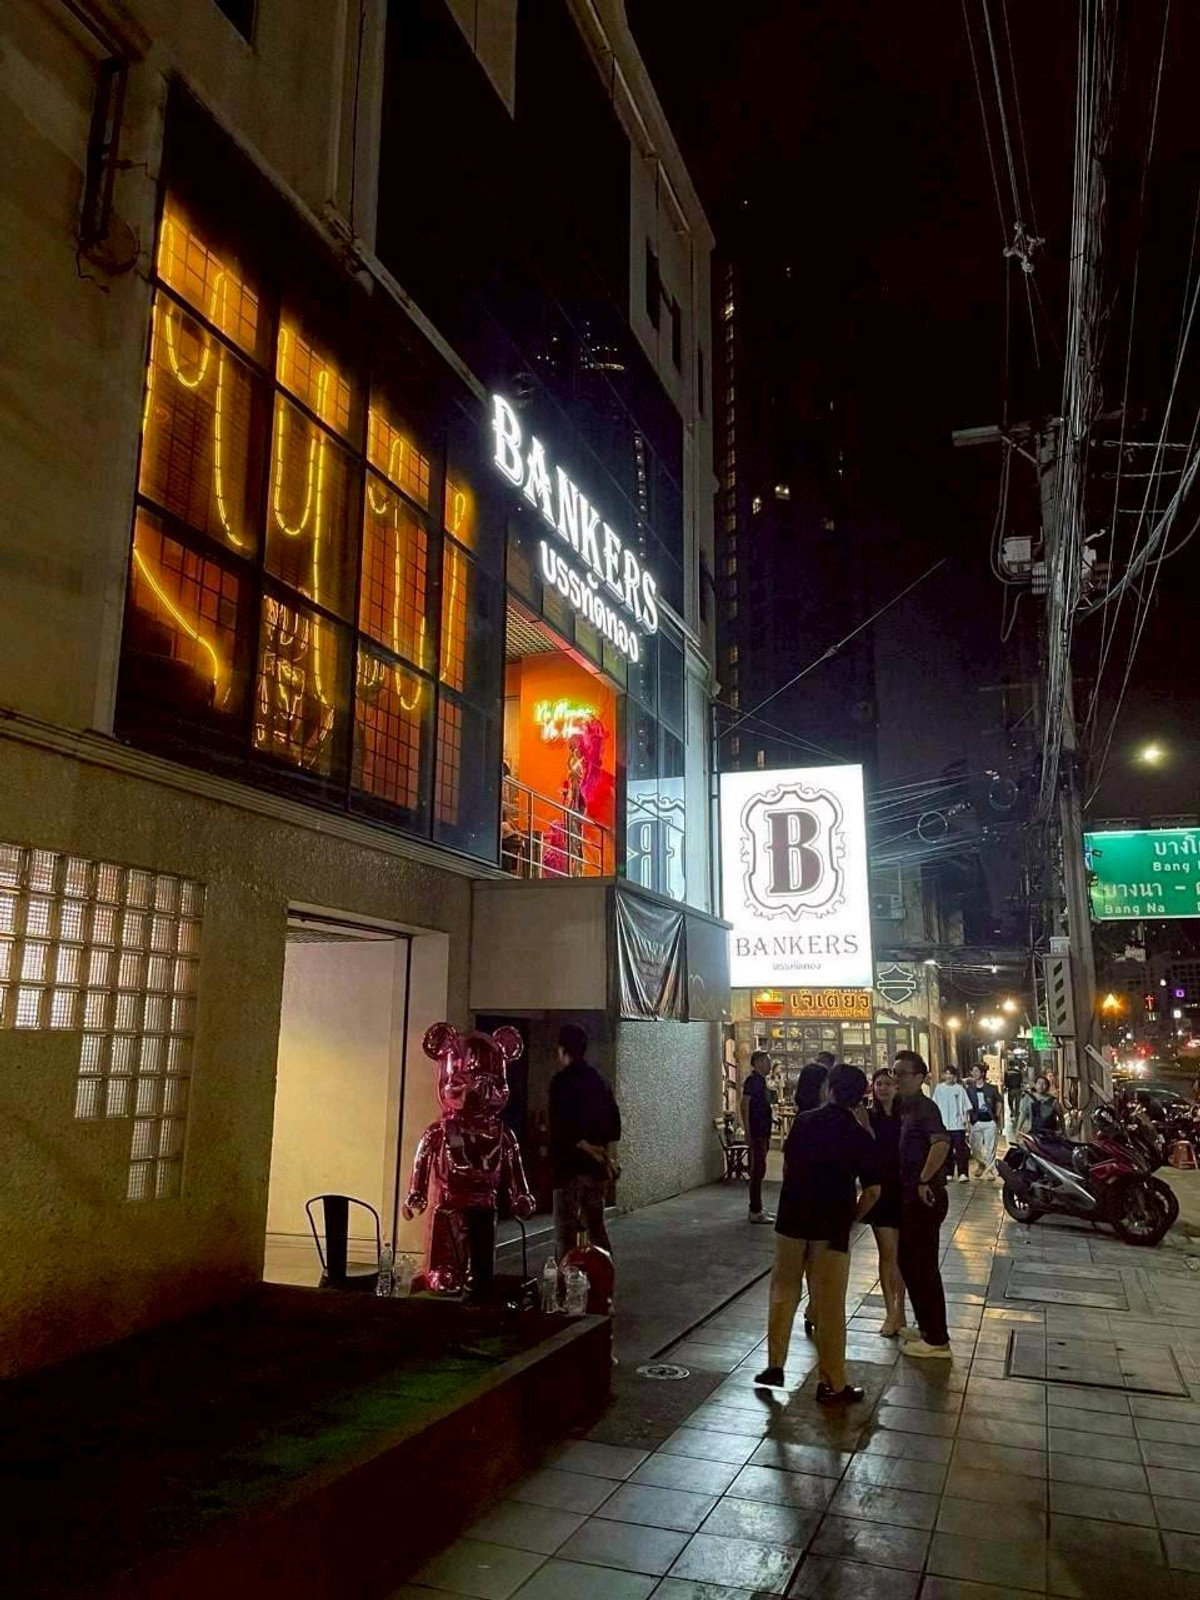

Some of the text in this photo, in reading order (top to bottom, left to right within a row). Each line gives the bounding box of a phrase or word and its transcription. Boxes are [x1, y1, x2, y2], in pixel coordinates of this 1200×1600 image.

[493, 394, 658, 634] BANKERS
[764, 808, 824, 897] B
[1154, 834, 1200, 856] บางโ
[1152, 861, 1190, 874] Bang
[1104, 882, 1163, 899] บางนา
[1104, 902, 1166, 915] Bang Na
[736, 933, 859, 957] BANKERS
